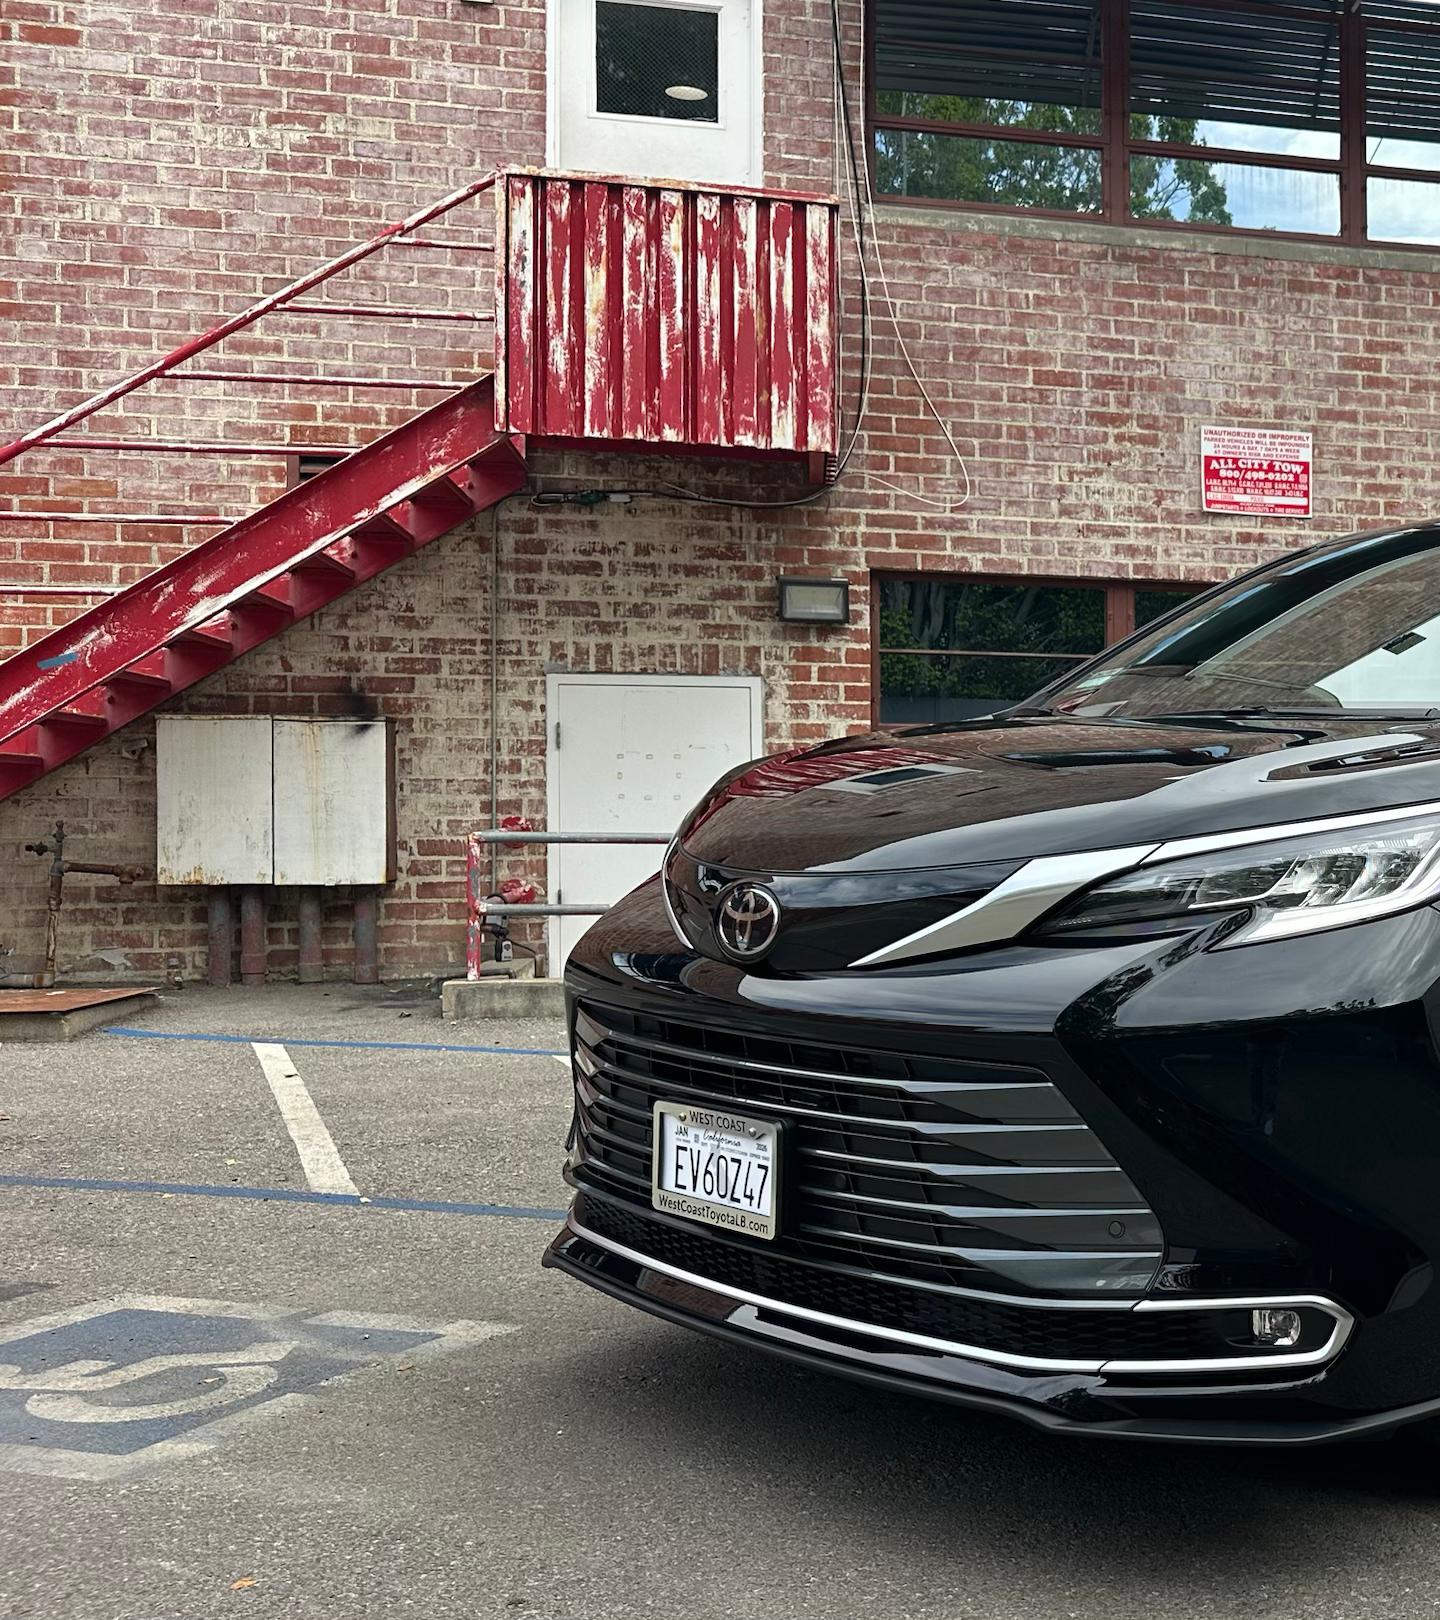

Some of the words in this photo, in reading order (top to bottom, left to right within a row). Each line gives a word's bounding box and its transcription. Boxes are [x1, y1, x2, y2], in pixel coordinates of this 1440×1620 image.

[1204, 429, 1255, 439] UNAUTHORIZED
[1257, 432, 1267, 440] OR
[1268, 433, 1310, 442] IMPROPERLY
[1210, 459, 1236, 469] ALL
[1238, 459, 1271, 470] CITY
[1272, 460, 1304, 474] TOW
[1219, 470, 1295, 481] 800/498-0202
[689, 1110, 714, 1127] WEST
[716, 1116, 746, 1133] COAST
[675, 1126, 689, 1137] JAN
[703, 1128, 741, 1149] California
[675, 1144, 769, 1209] EV60Z47
[658, 1193, 769, 1235] WestCoastToyotaLB.com
